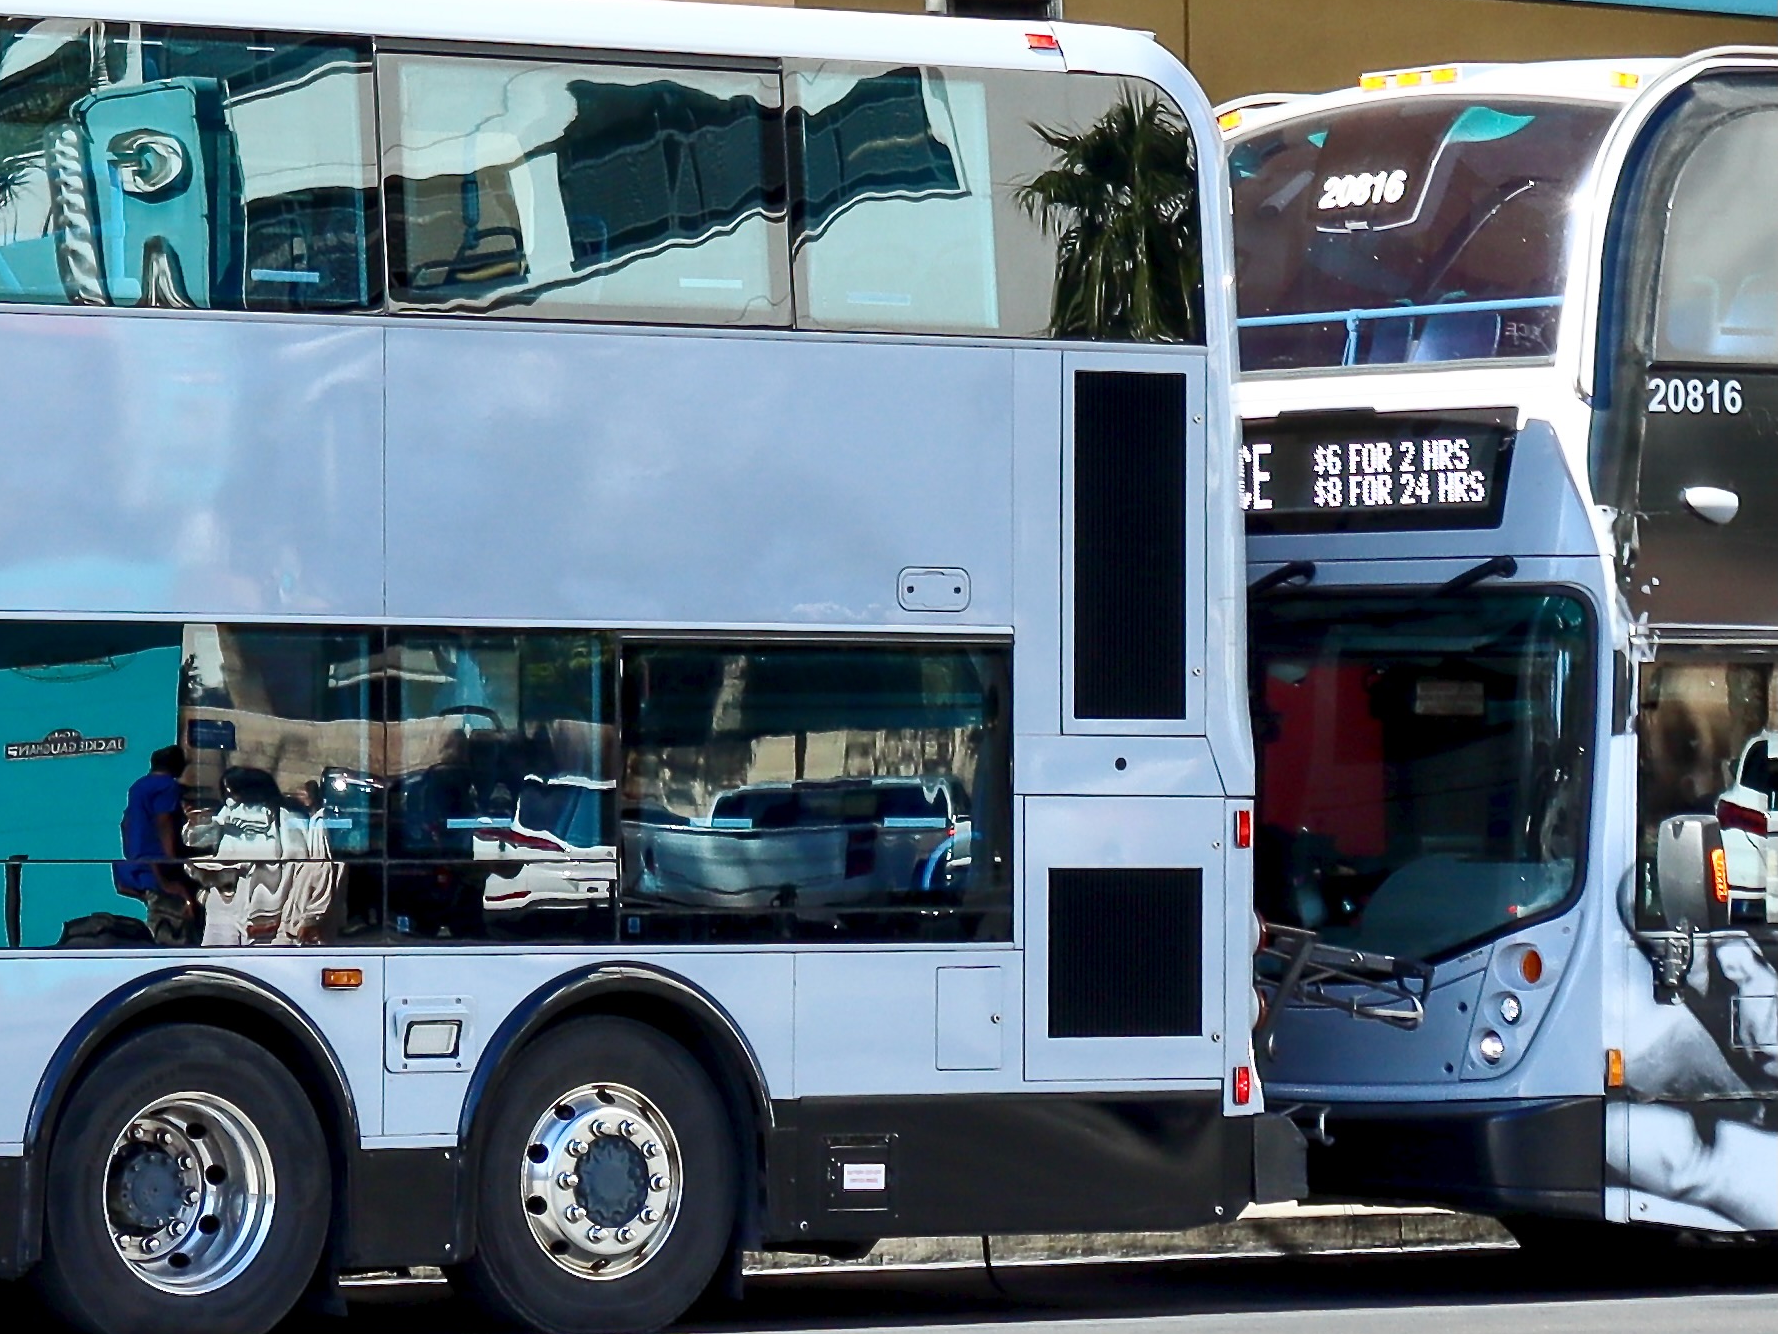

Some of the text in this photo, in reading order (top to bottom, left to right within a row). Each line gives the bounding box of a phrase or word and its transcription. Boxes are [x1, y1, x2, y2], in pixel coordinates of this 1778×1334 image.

[1318, 169, 1408, 210] 20816
[1647, 378, 1743, 414] 20816
[1313, 438, 1470, 475] $6 FOR 2 HRS
[1313, 470, 1486, 507] $8 FOR 24 HRS
